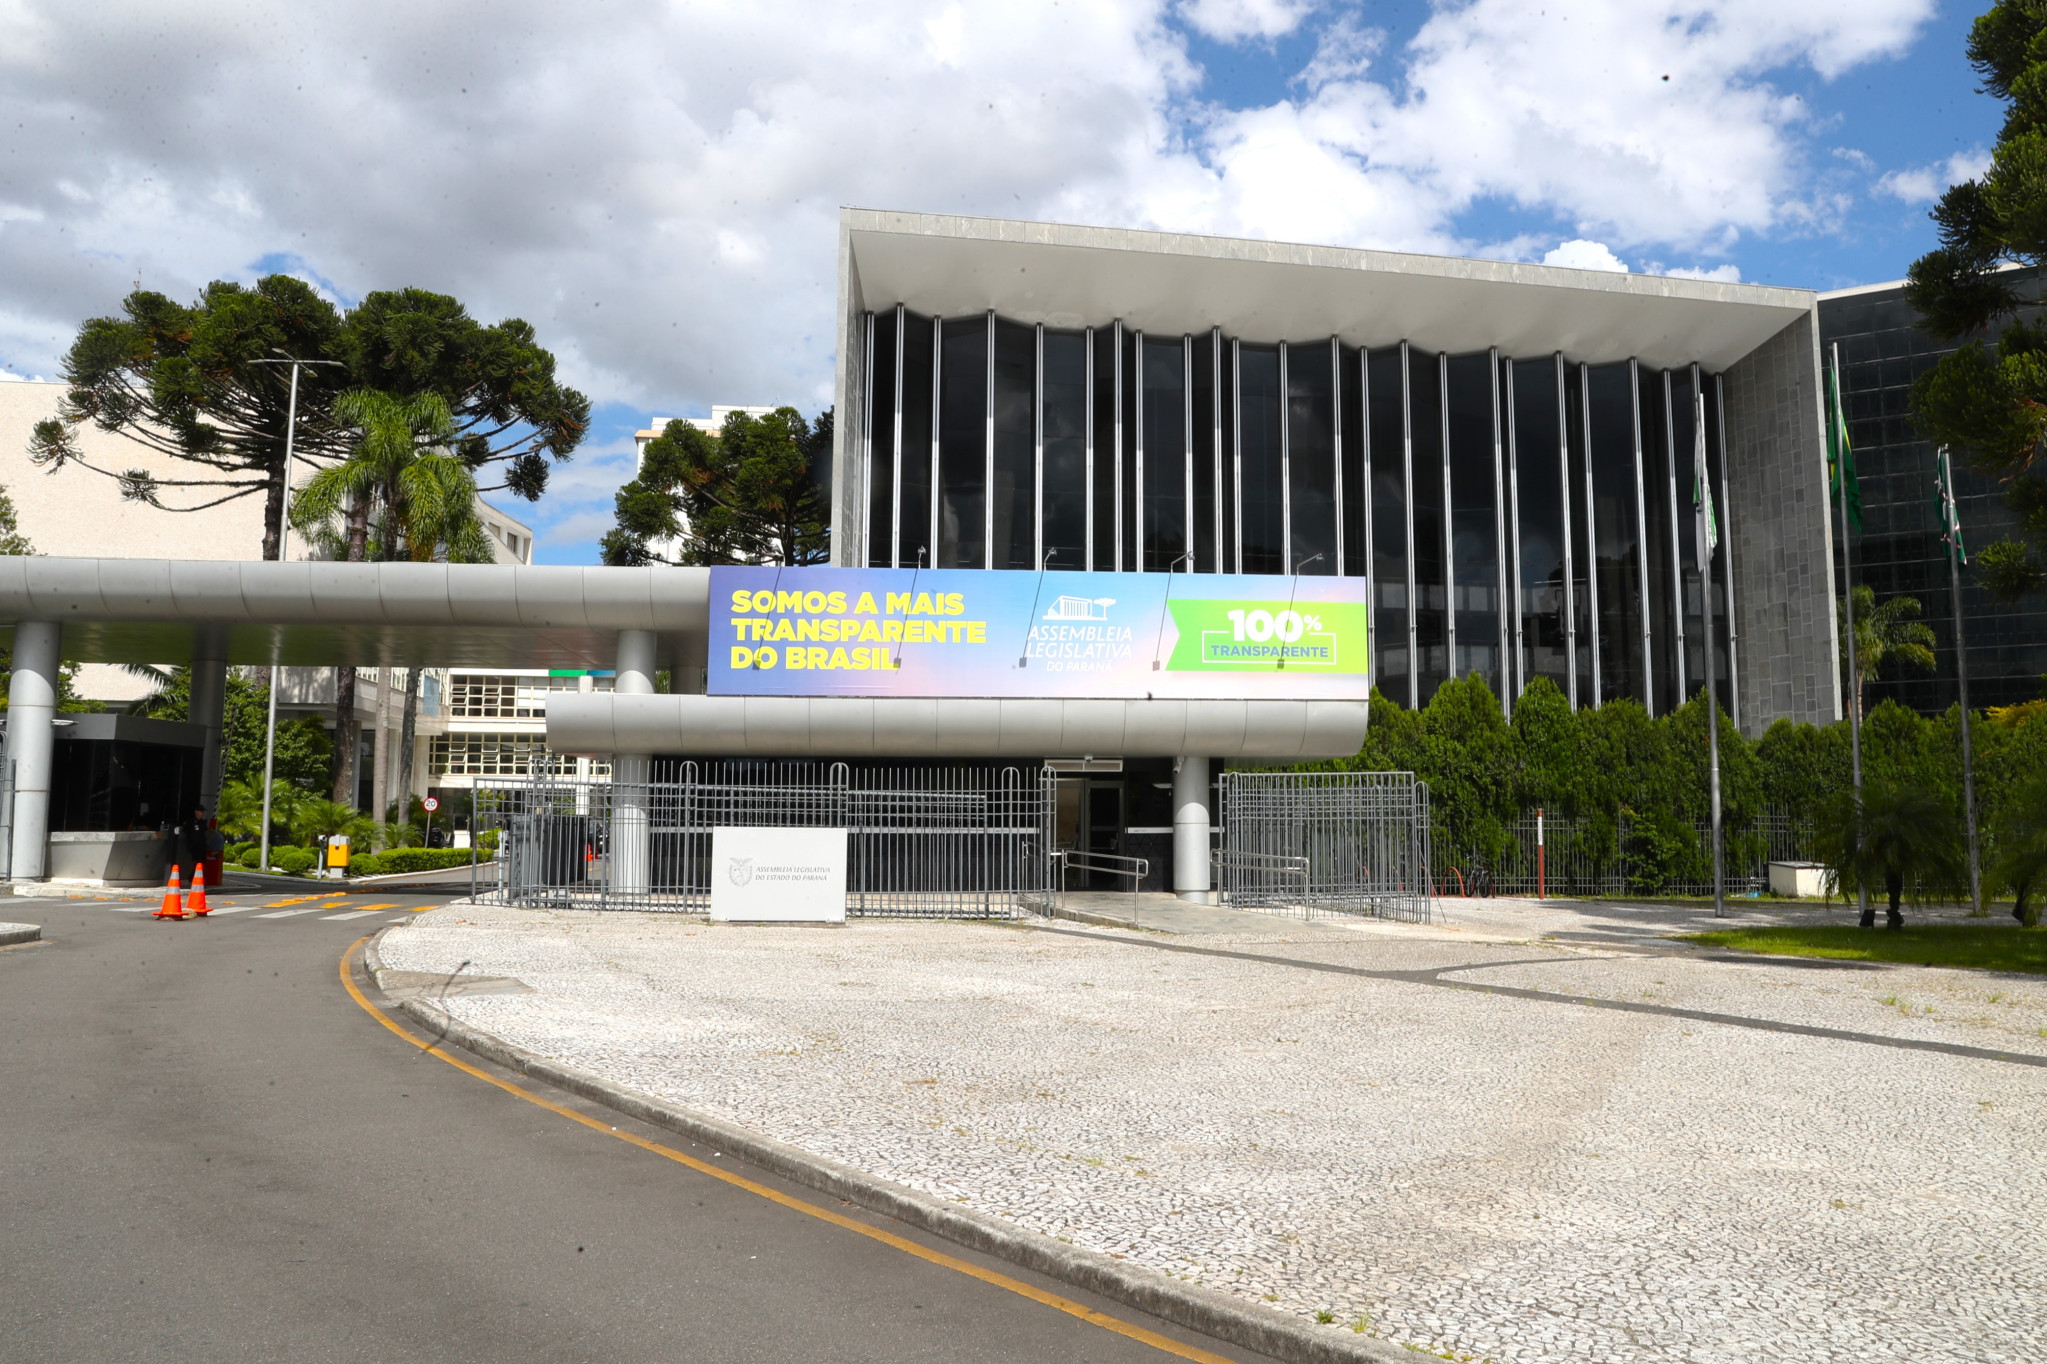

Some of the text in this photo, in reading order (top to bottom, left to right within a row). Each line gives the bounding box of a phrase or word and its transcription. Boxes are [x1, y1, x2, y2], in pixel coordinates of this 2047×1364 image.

[731, 590, 965, 615] SOMOS A MAIS
[731, 618, 987, 643] TRANSPARENTE
[1027, 625, 1132, 642] ASSEMBLEIA
[1227, 609, 1323, 642] 100%
[731, 646, 899, 670] DO BRASIL
[1026, 642, 1132, 659] LEGISLATIVA
[1211, 645, 1328, 657] TRANSPARENTE
[1047, 659, 1113, 673] DO PARANÁ
[425, 800, 436, 808] 20
